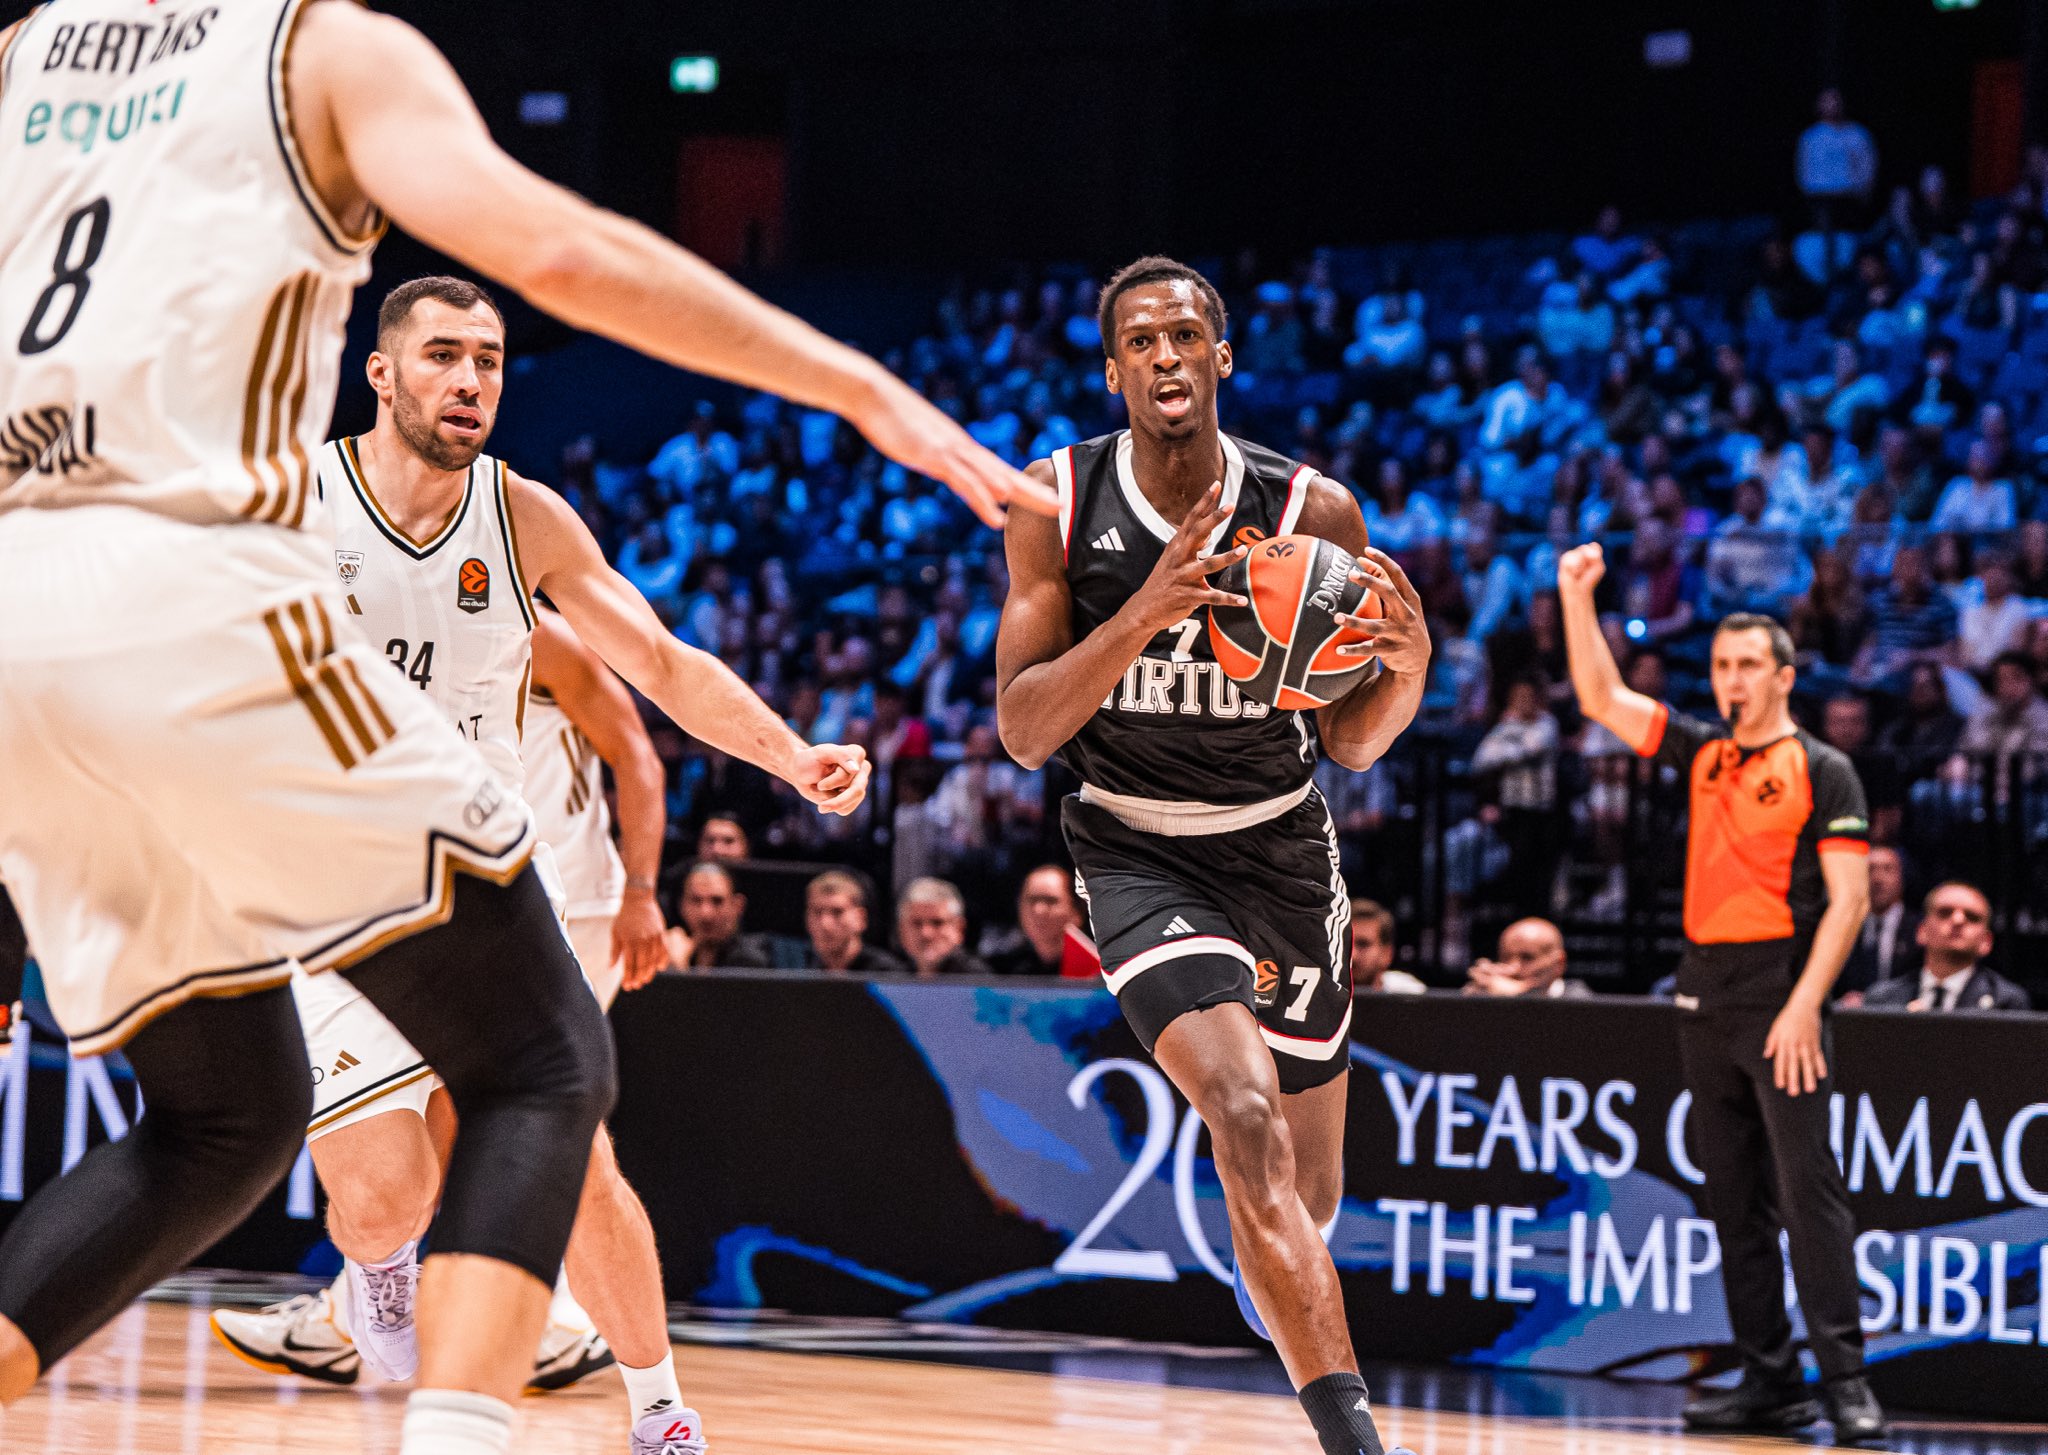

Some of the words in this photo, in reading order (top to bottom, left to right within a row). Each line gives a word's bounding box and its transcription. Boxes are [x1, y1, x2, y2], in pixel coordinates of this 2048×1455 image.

[18, 196, 111, 355] 8
[385, 638, 434, 690] 34
[1168, 618, 1202, 662] 7
[1100, 655, 1270, 719] IRTU
[1284, 966, 1321, 1022] 7
[1381, 1071, 1639, 1179] YEARS
[1376, 1198, 1538, 1303] THE
[1568, 1211, 2048, 1347] IMPSIBL
